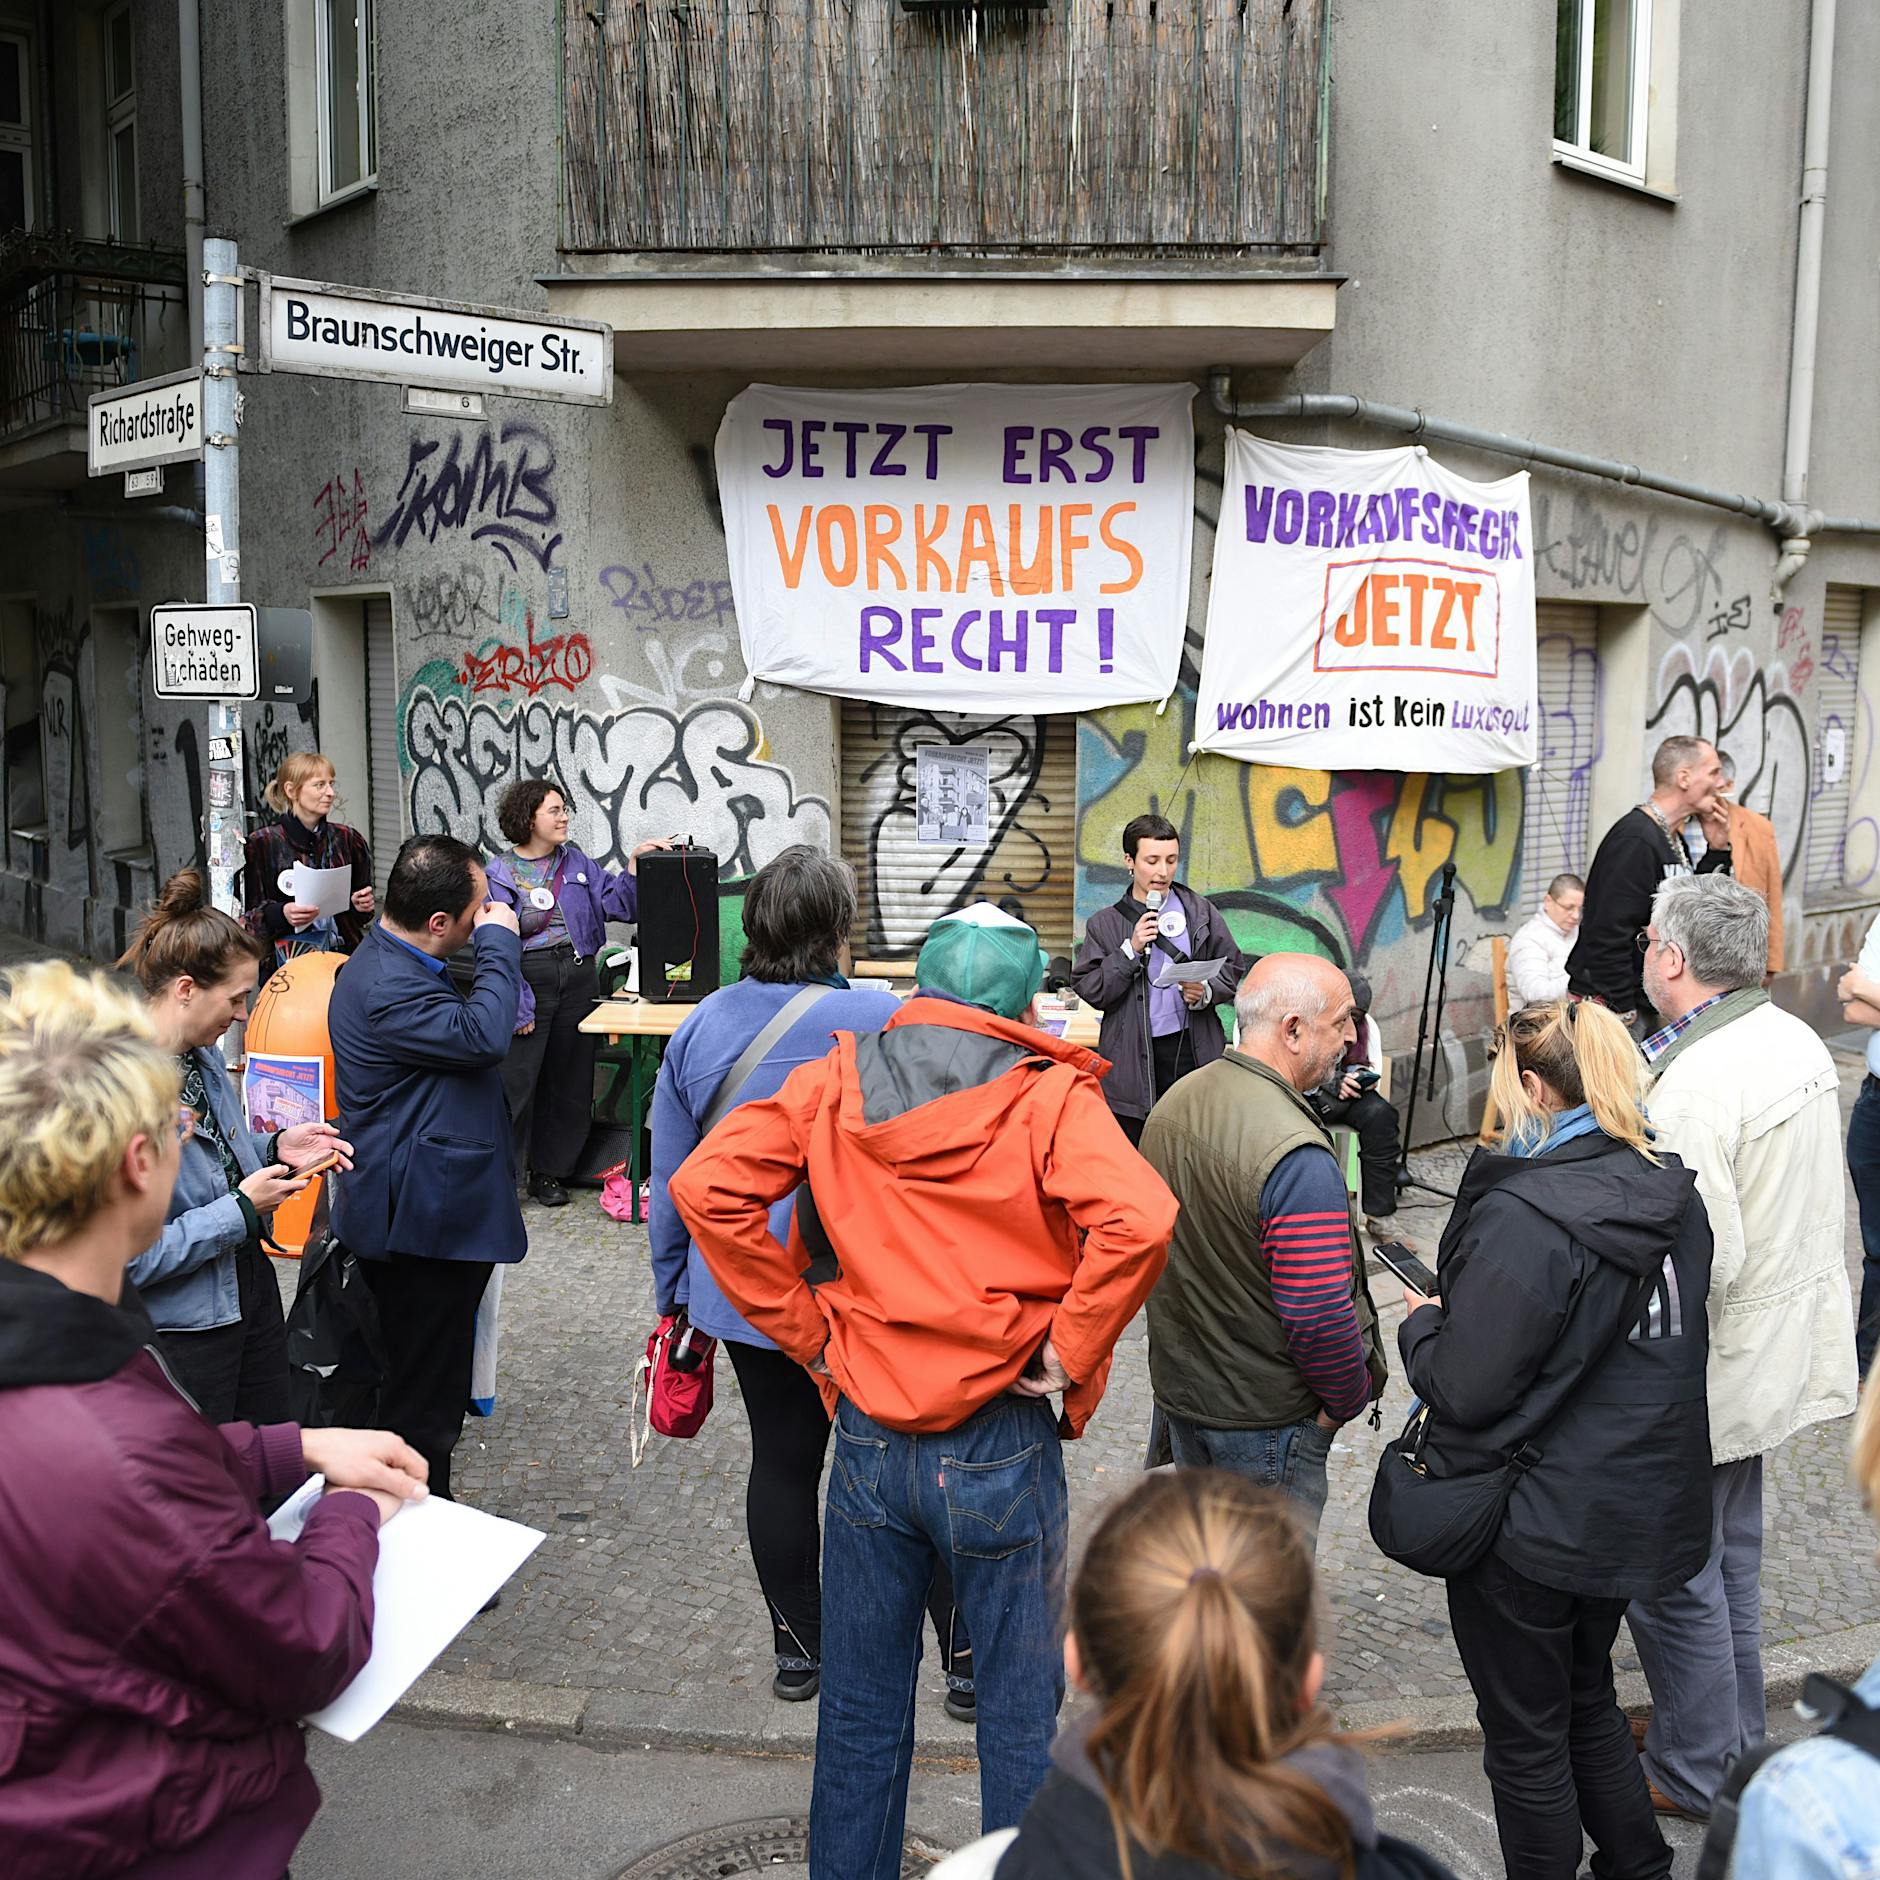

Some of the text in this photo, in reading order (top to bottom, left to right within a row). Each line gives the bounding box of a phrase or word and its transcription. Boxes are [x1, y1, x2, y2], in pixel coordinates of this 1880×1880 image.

[287, 299, 584, 375] Braunschweiger Str.
[100, 393, 194, 447] Richardstraße
[461, 396, 470, 408] 6
[762, 419, 1160, 484] JETZT ERST
[766, 502, 1143, 597] VORKAUFS
[1245, 484, 1523, 560] VORKAUFSRECHT
[165, 623, 241, 652] Gehweg-
[860, 606, 1114, 674] RECHT!
[1334, 574, 1482, 652] JETZT
[166, 657, 241, 681] chäden
[1349, 695, 1385, 728] ist
